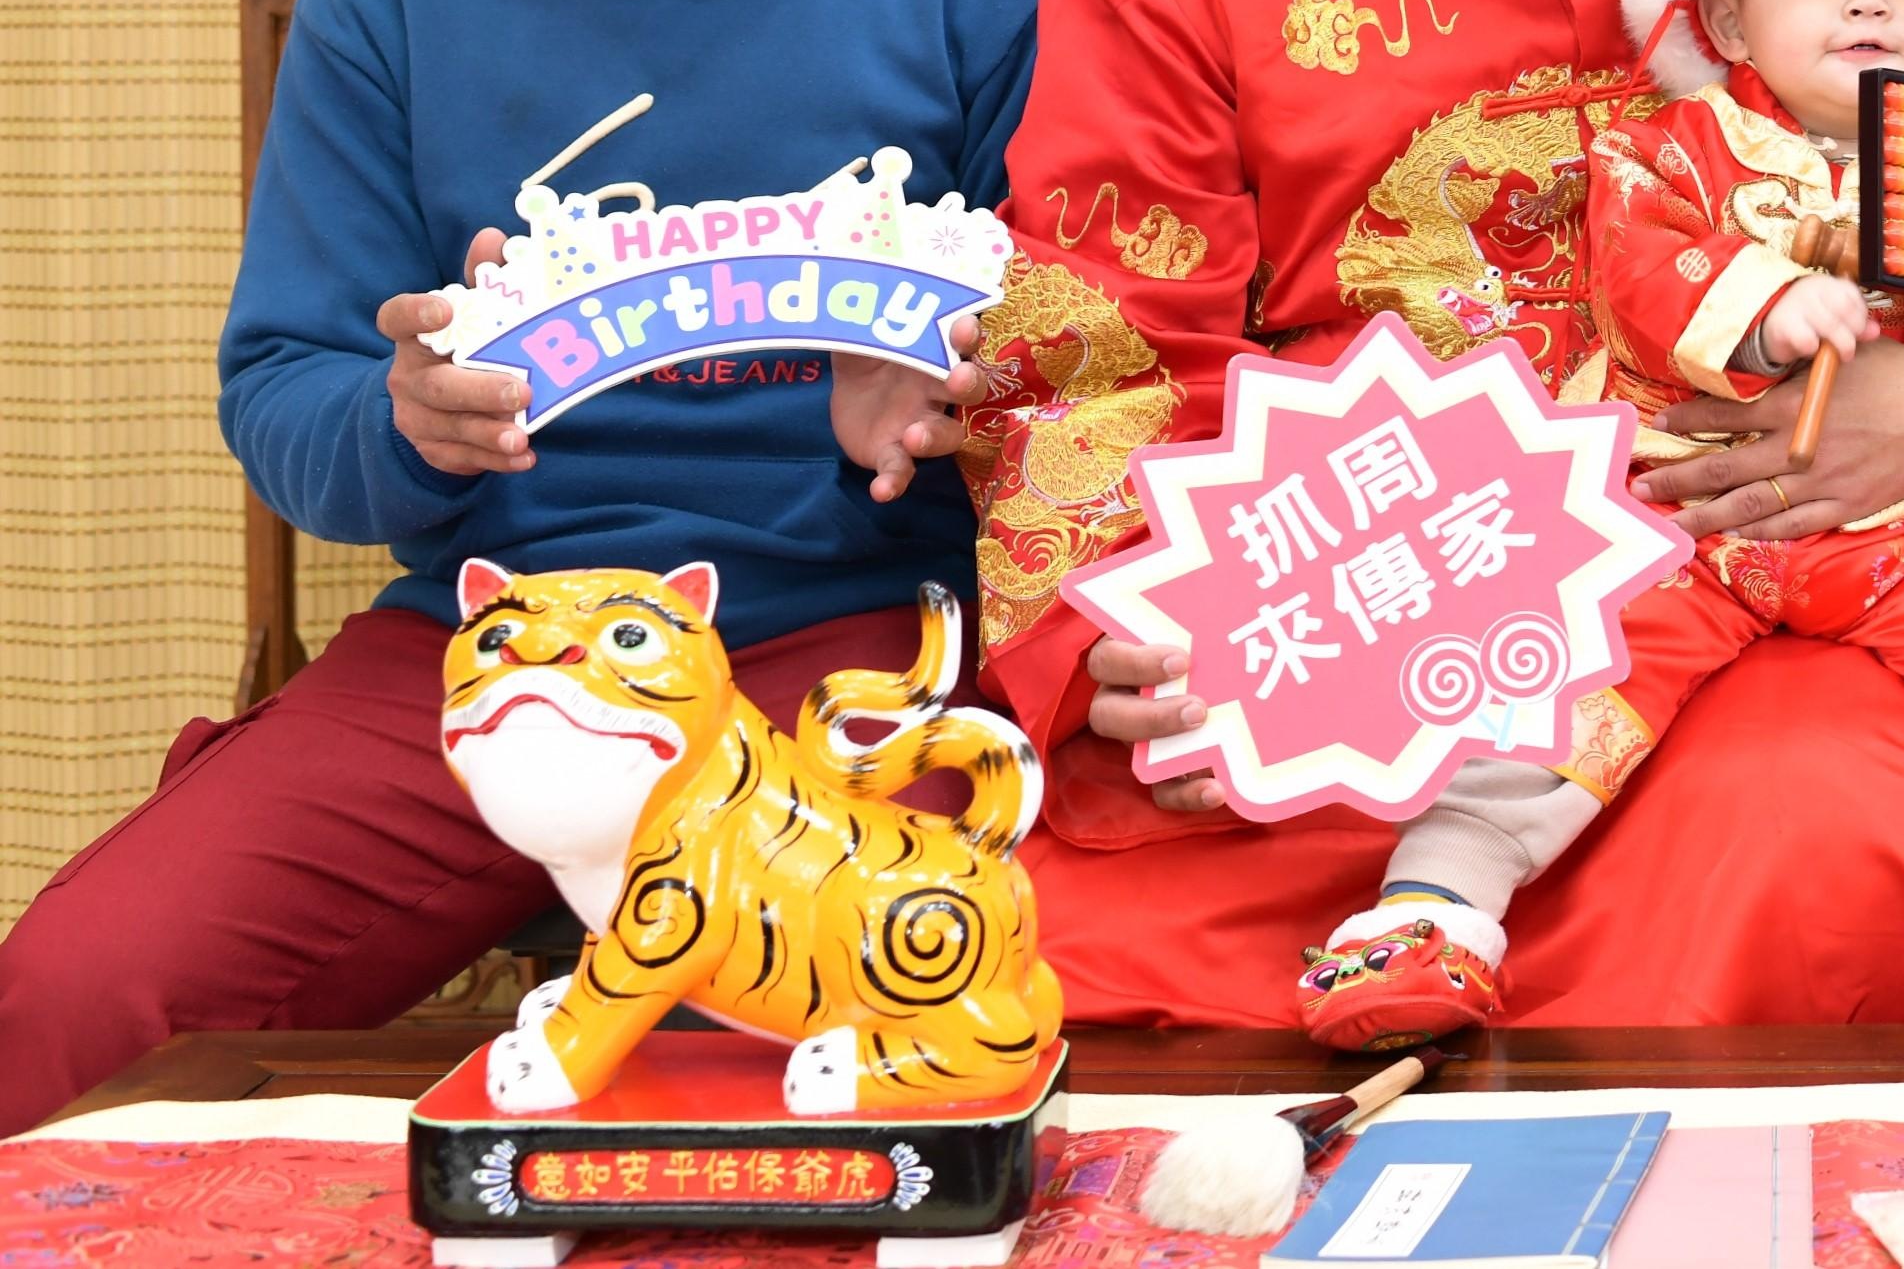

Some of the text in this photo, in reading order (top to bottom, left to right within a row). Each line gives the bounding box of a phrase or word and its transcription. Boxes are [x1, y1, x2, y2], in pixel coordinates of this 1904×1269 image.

[612, 200, 824, 262] HAPPY
[520, 260, 941, 389] Birthday
[1227, 415, 1439, 590] 抓周
[1227, 478, 1537, 700] 來傳家
